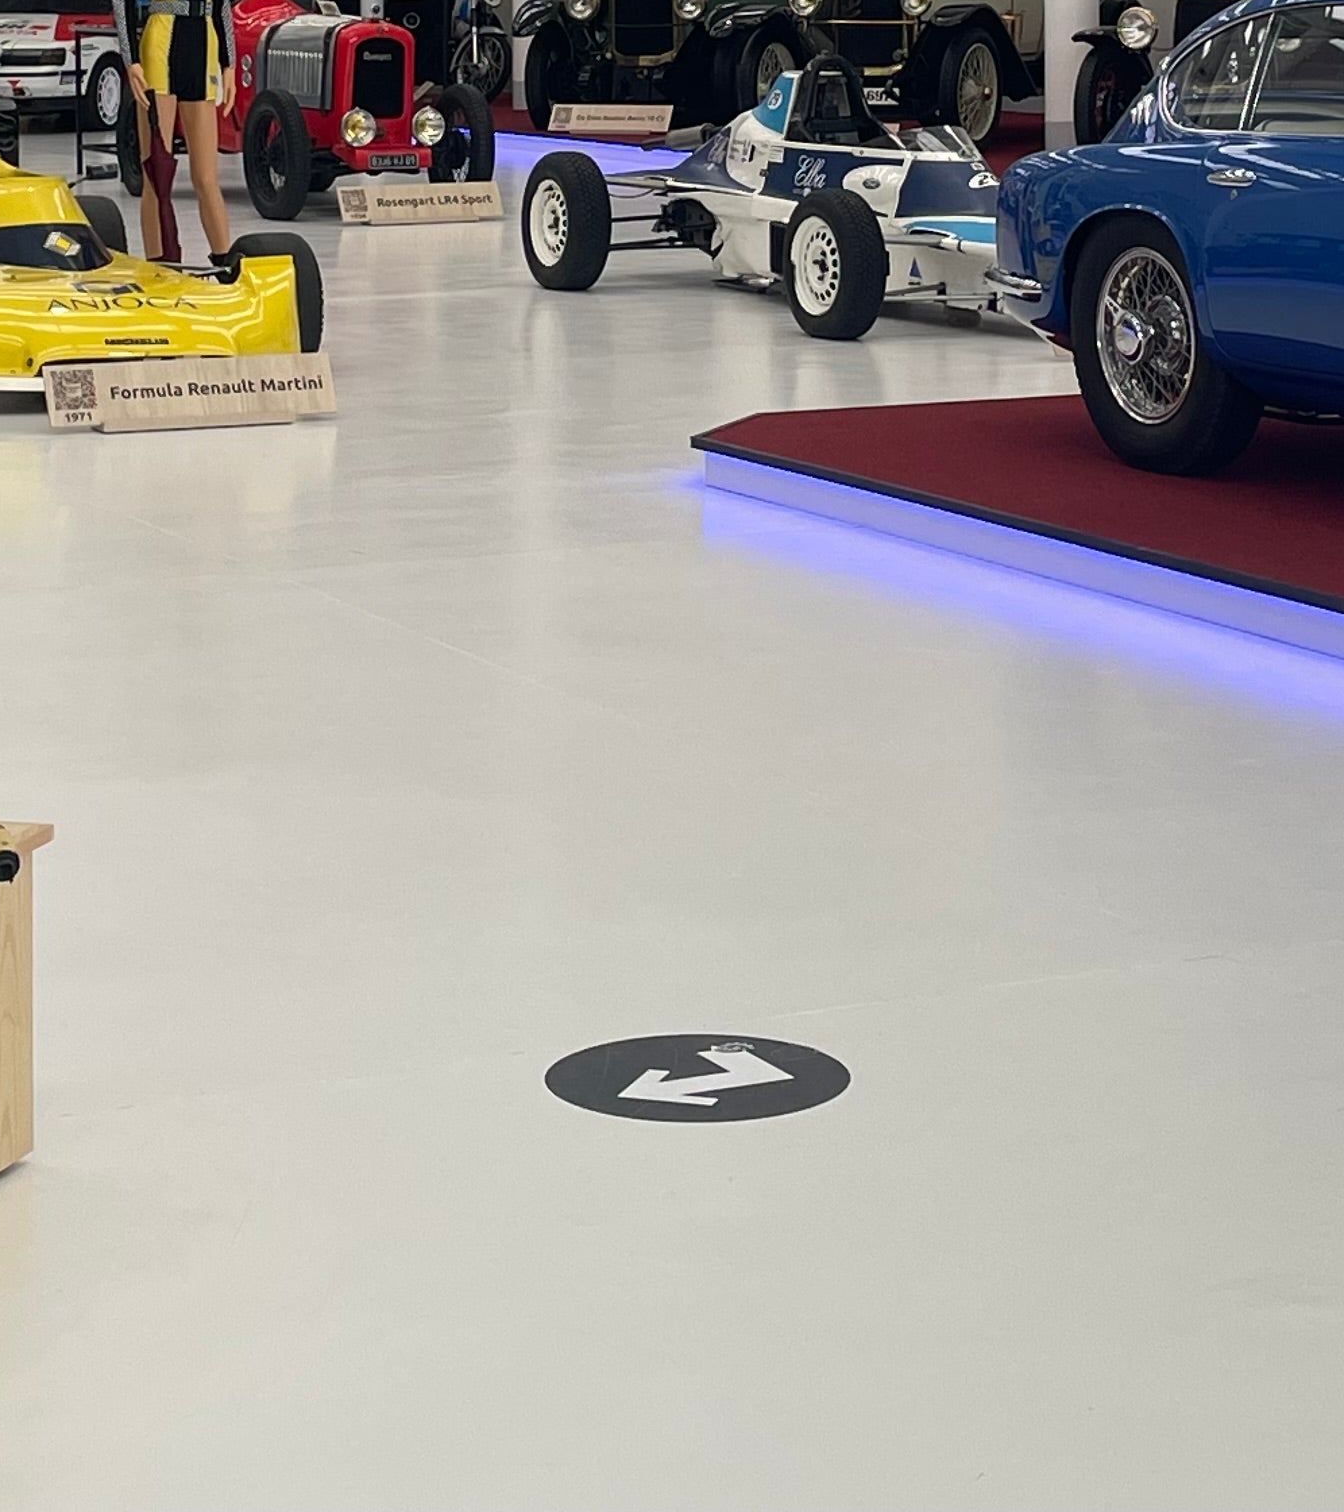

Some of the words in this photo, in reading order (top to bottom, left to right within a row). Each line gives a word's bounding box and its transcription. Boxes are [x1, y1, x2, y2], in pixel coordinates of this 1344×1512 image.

[793, 154, 827, 189] Elba
[376, 197, 435, 208] Rosengart
[437, 196, 459, 206] LR4
[462, 194, 493, 207] Sport
[48, 296, 198, 313] ANJOCA
[109, 382, 183, 401] Formula
[188, 378, 256, 397] Renault
[261, 374, 324, 392] Martini
[64, 411, 93, 423] 1971
